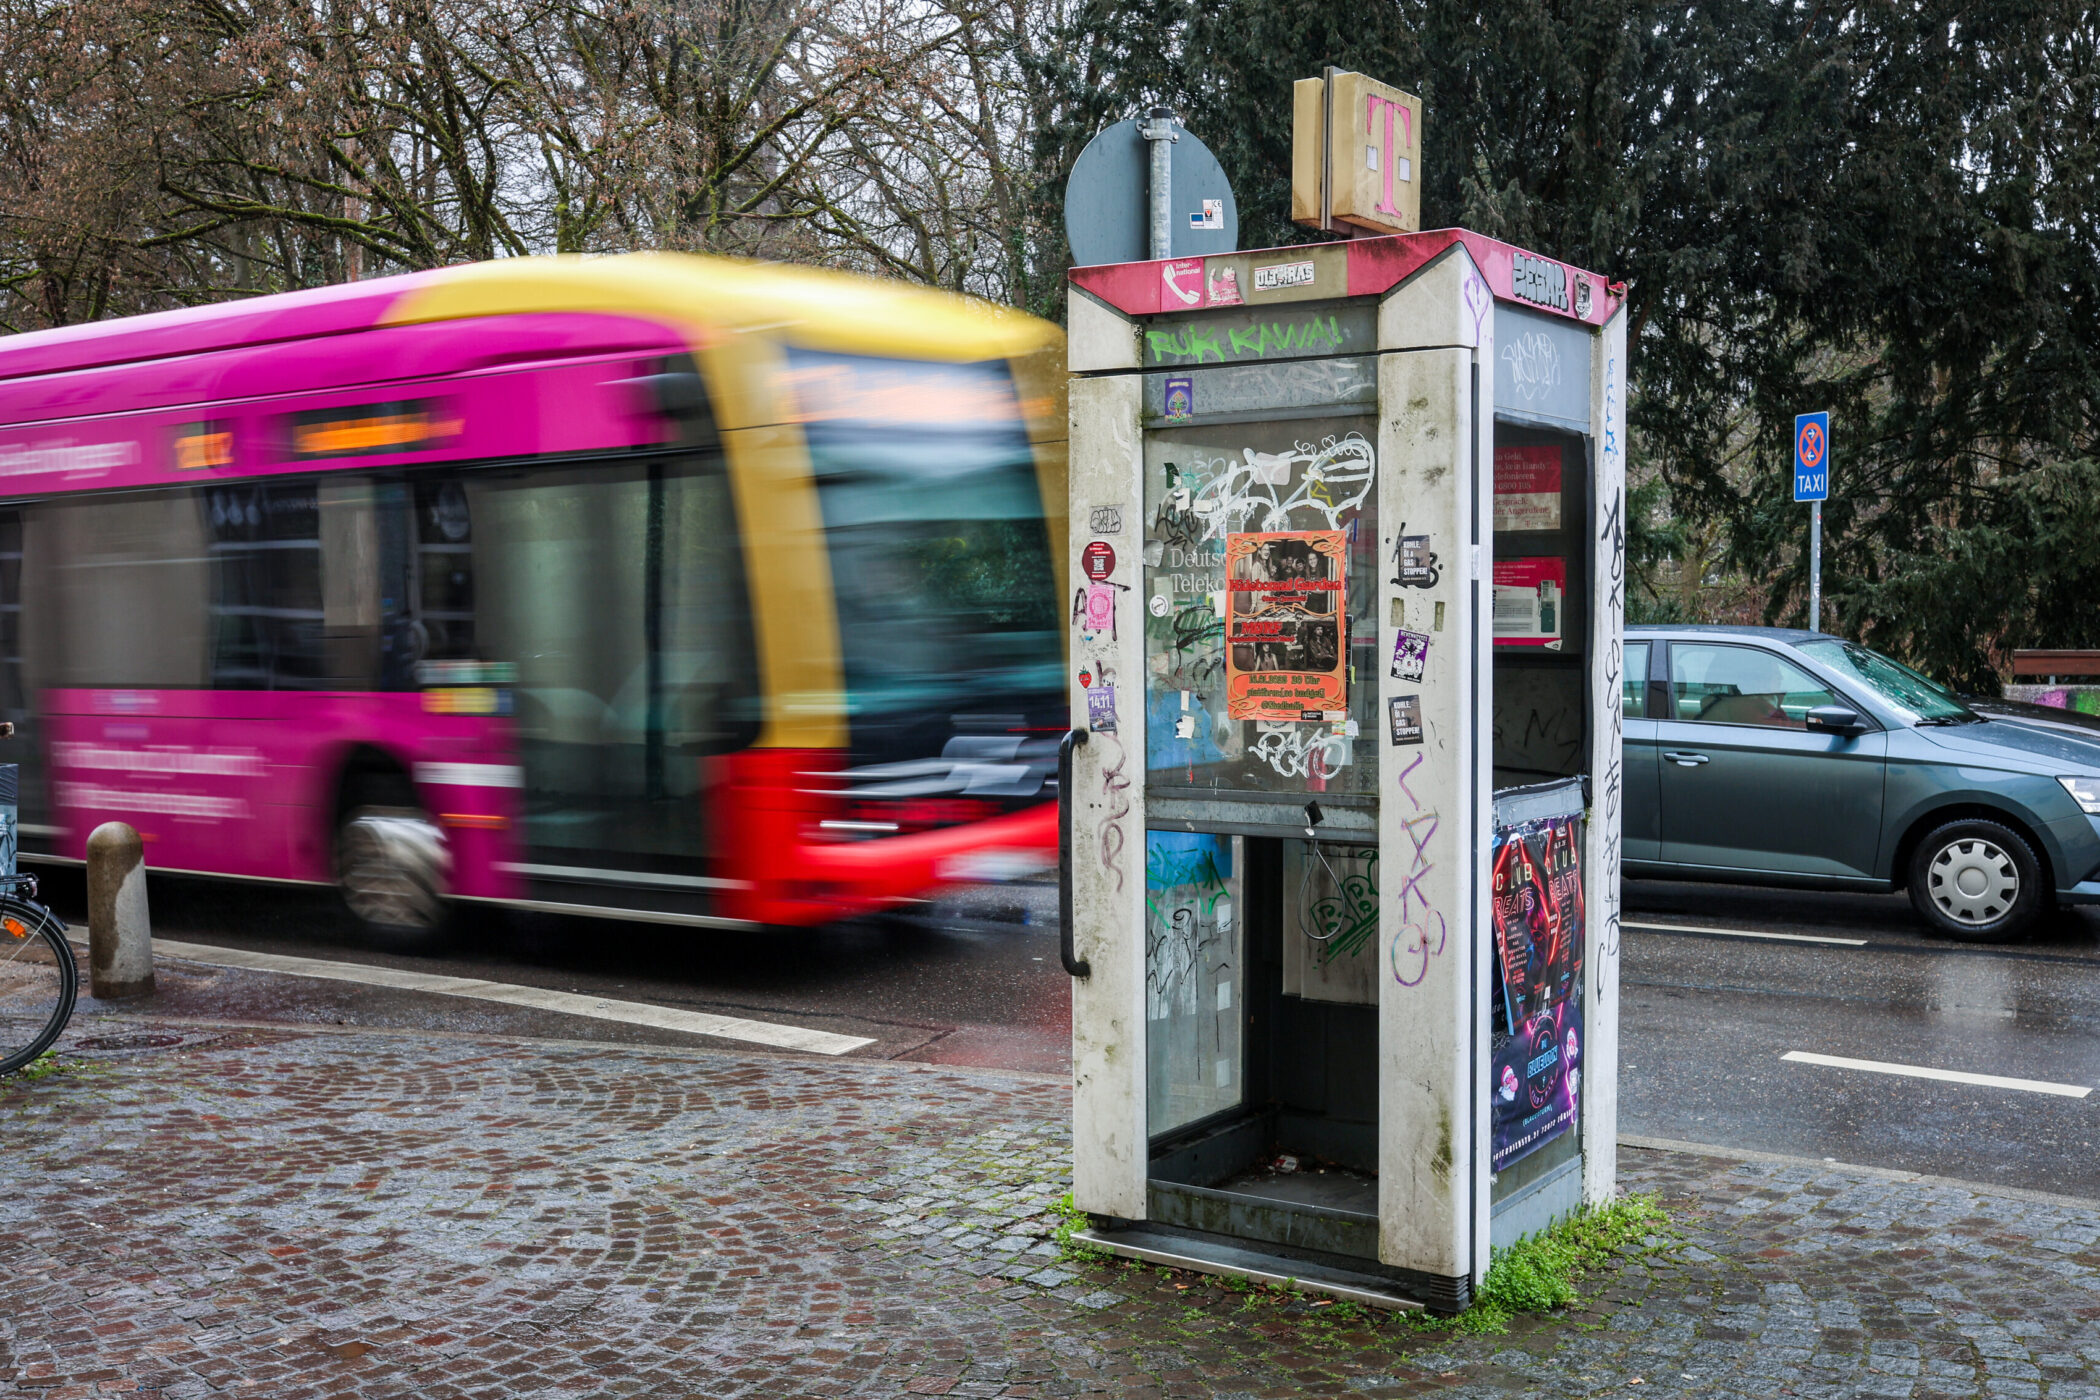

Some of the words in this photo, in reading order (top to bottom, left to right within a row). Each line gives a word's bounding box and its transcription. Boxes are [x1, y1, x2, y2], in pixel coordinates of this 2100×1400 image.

[1367, 93, 1411, 219] T
[1176, 267, 1200, 276] national
[1228, 316, 1343, 357] KAWA!
[1797, 473, 1824, 493] TAXI
[1170, 548, 1226, 568] Deutsc
[1170, 573, 1226, 593] Teleko
[1494, 886, 1535, 921] BEATS
